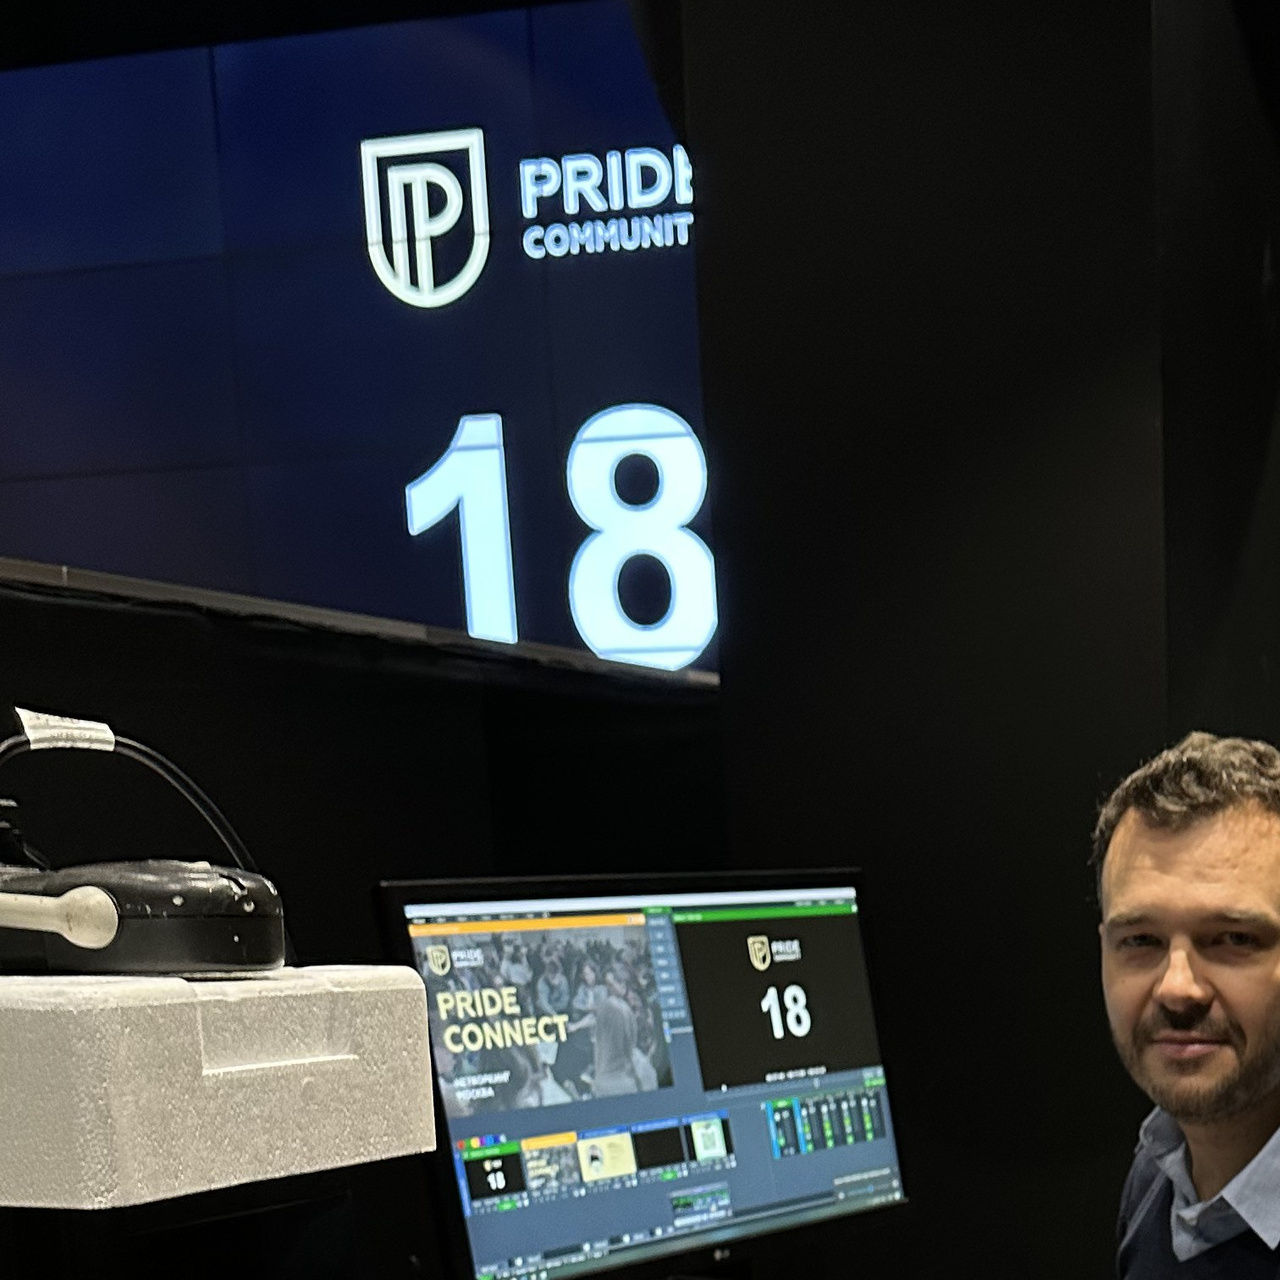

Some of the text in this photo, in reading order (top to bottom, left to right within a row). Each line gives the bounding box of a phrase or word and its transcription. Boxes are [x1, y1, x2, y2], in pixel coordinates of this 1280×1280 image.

[405, 402, 718, 671] 18
[436, 986, 521, 1020] PRIDE
[760, 984, 812, 1040] 18
[443, 1014, 569, 1053] CONNECT
